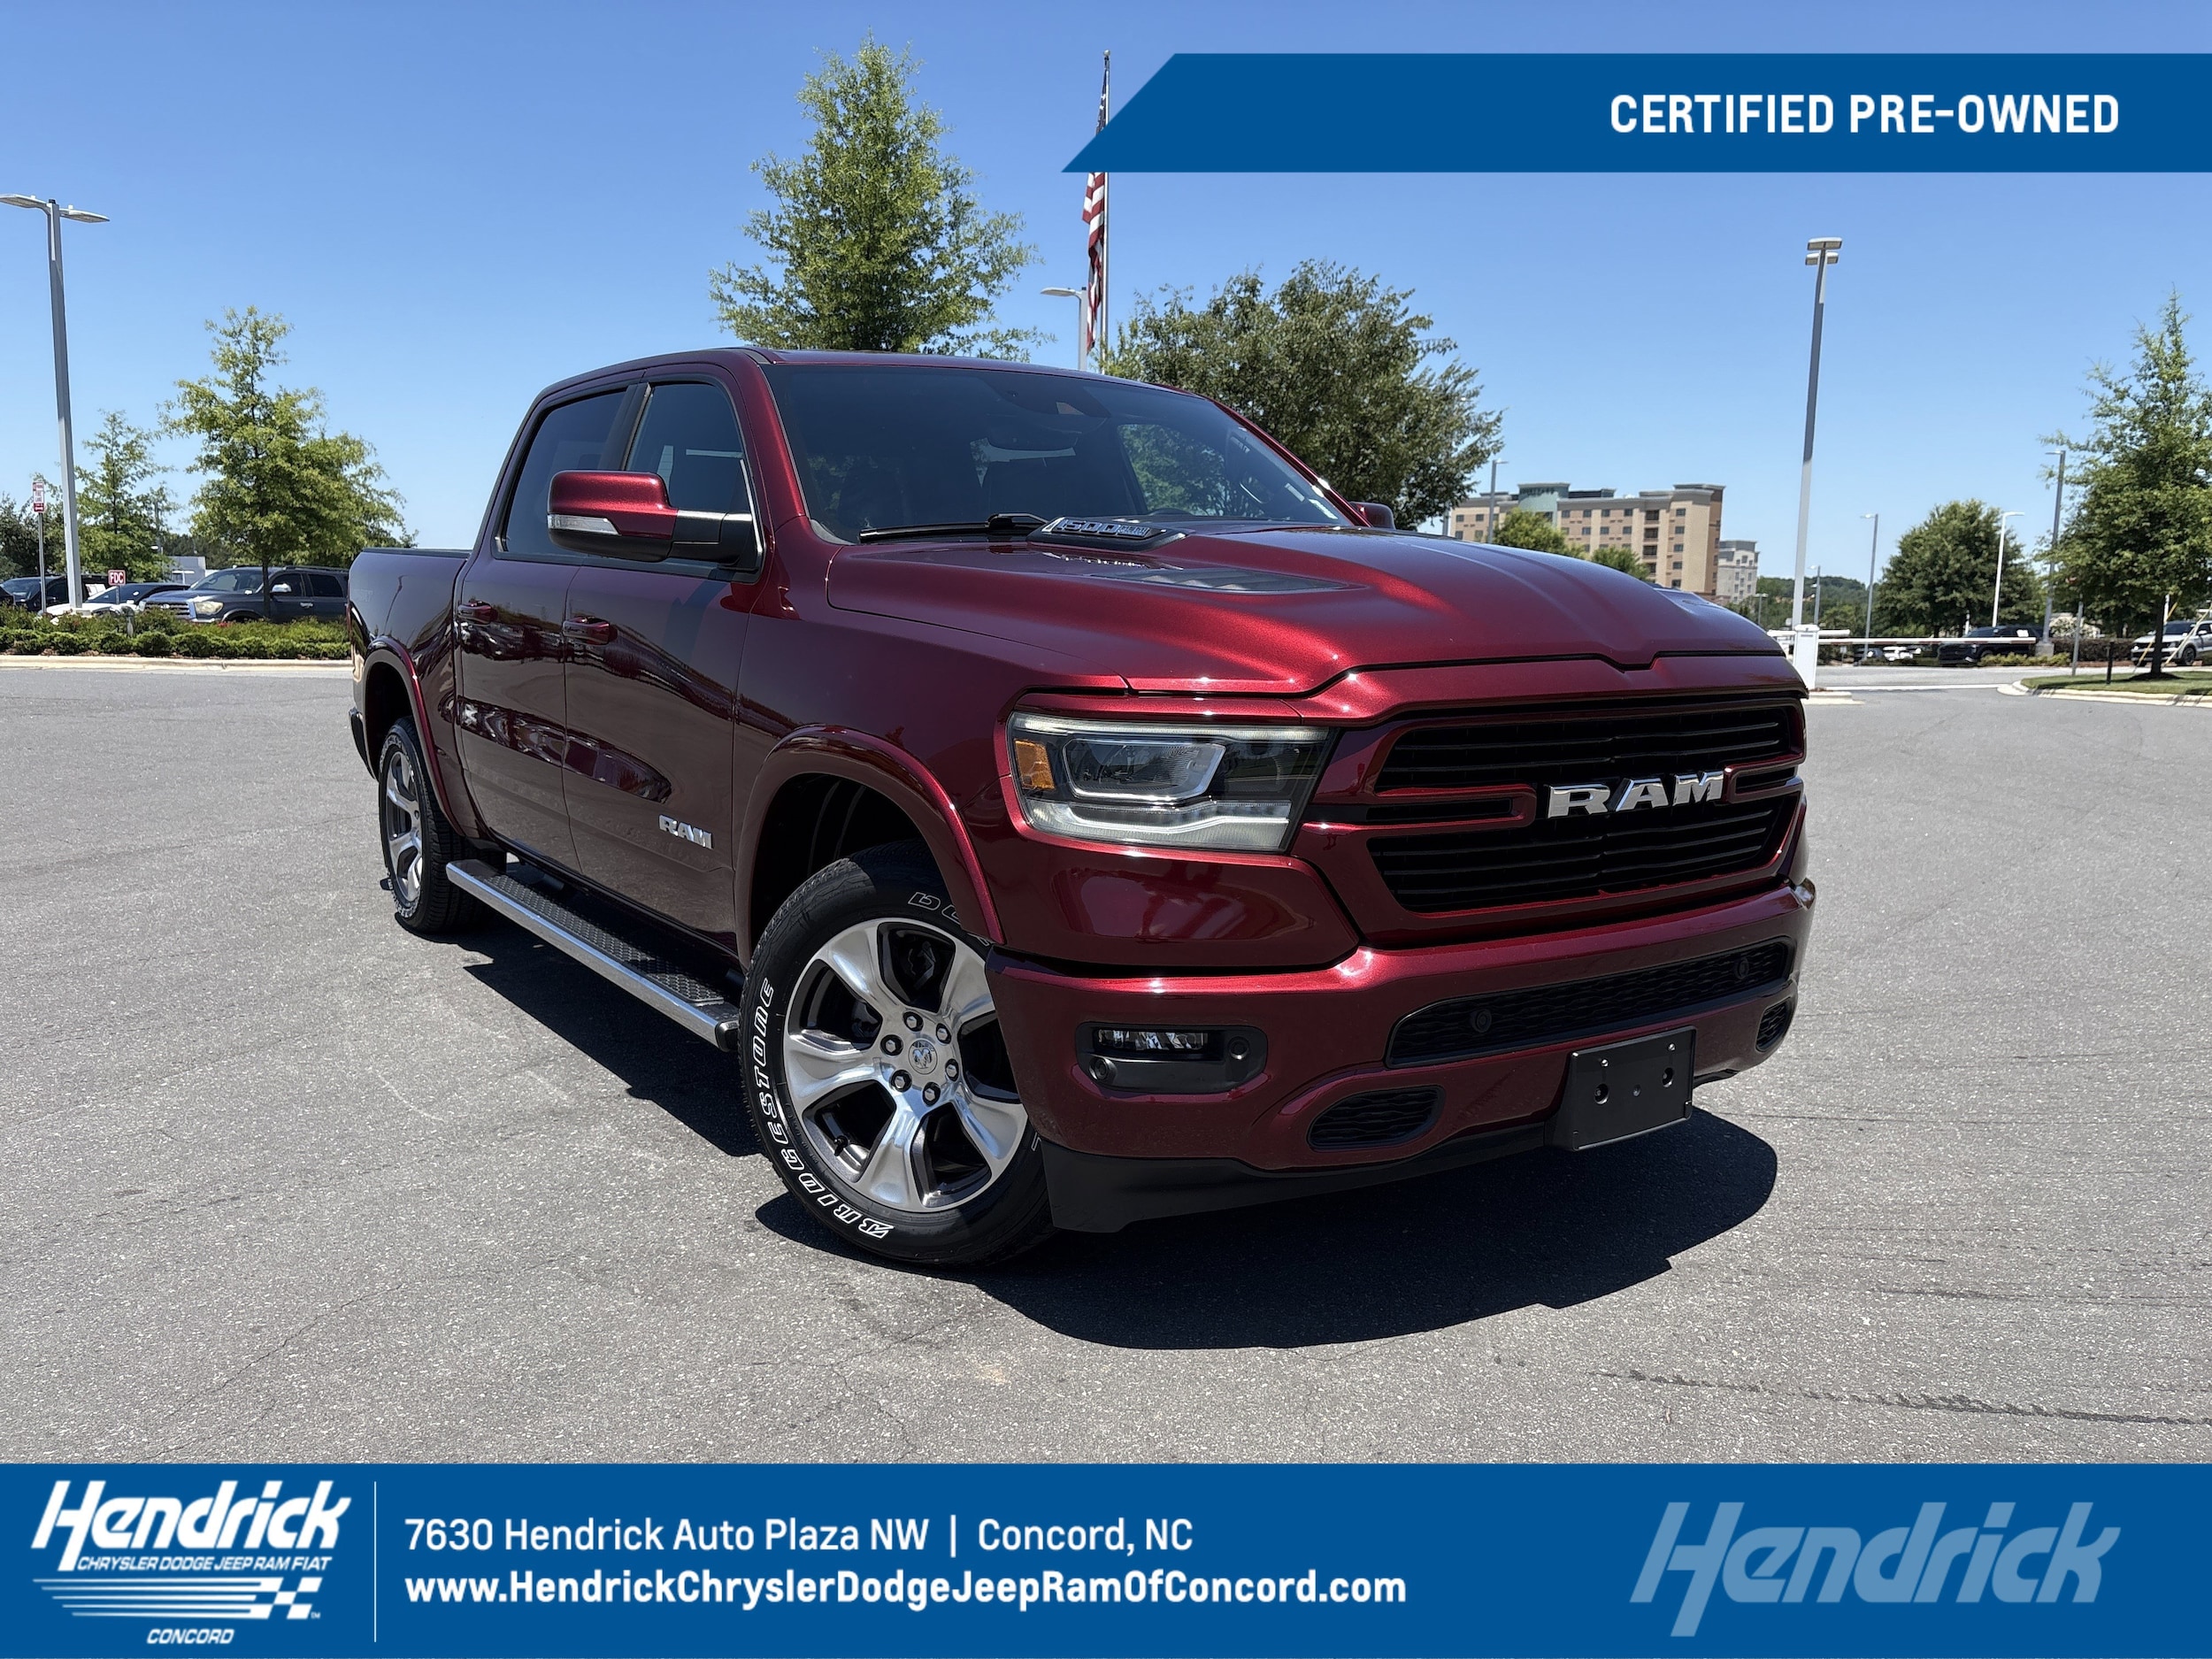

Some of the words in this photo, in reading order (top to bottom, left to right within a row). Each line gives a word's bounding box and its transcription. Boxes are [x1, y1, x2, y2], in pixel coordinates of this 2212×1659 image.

[1056, 518, 1121, 534] 1500
[110, 572, 124, 583] FDC
[1548, 770, 1724, 818] RAM
[658, 814, 712, 849] RAM
[752, 977, 895, 1240] BRIDGESTONE
